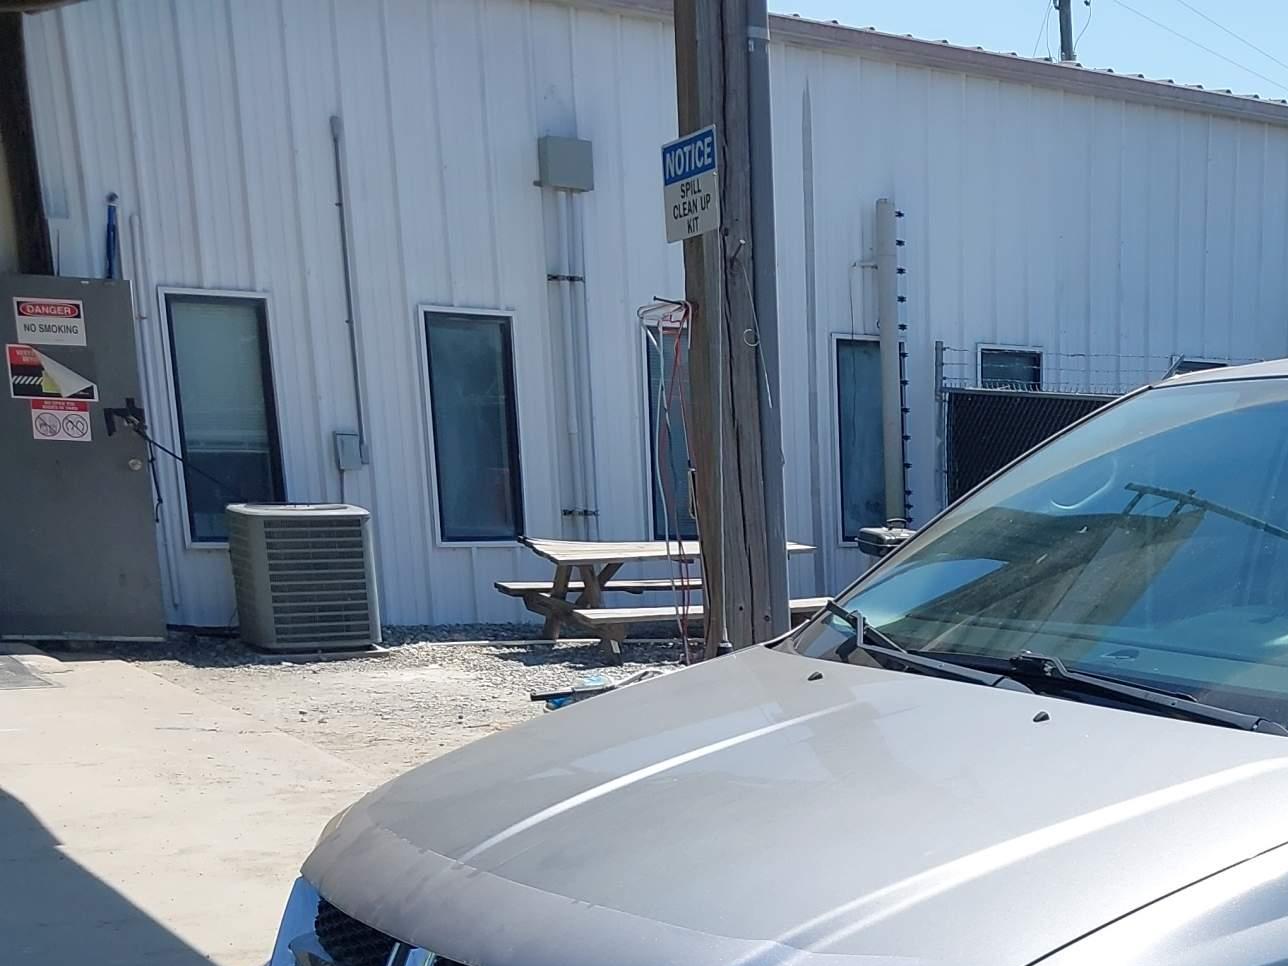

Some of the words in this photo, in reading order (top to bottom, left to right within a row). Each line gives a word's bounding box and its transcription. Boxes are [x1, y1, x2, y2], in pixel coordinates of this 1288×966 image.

[665, 136, 713, 180] NOTICE
[680, 177, 702, 199] SPILL
[673, 197, 698, 220] CLEAN
[700, 193, 711, 211] UP
[687, 216, 699, 234] KIT
[26, 304, 72, 315] DANGER
[23, 323, 37, 333] NO
[38, 323, 79, 335] SMOKING
